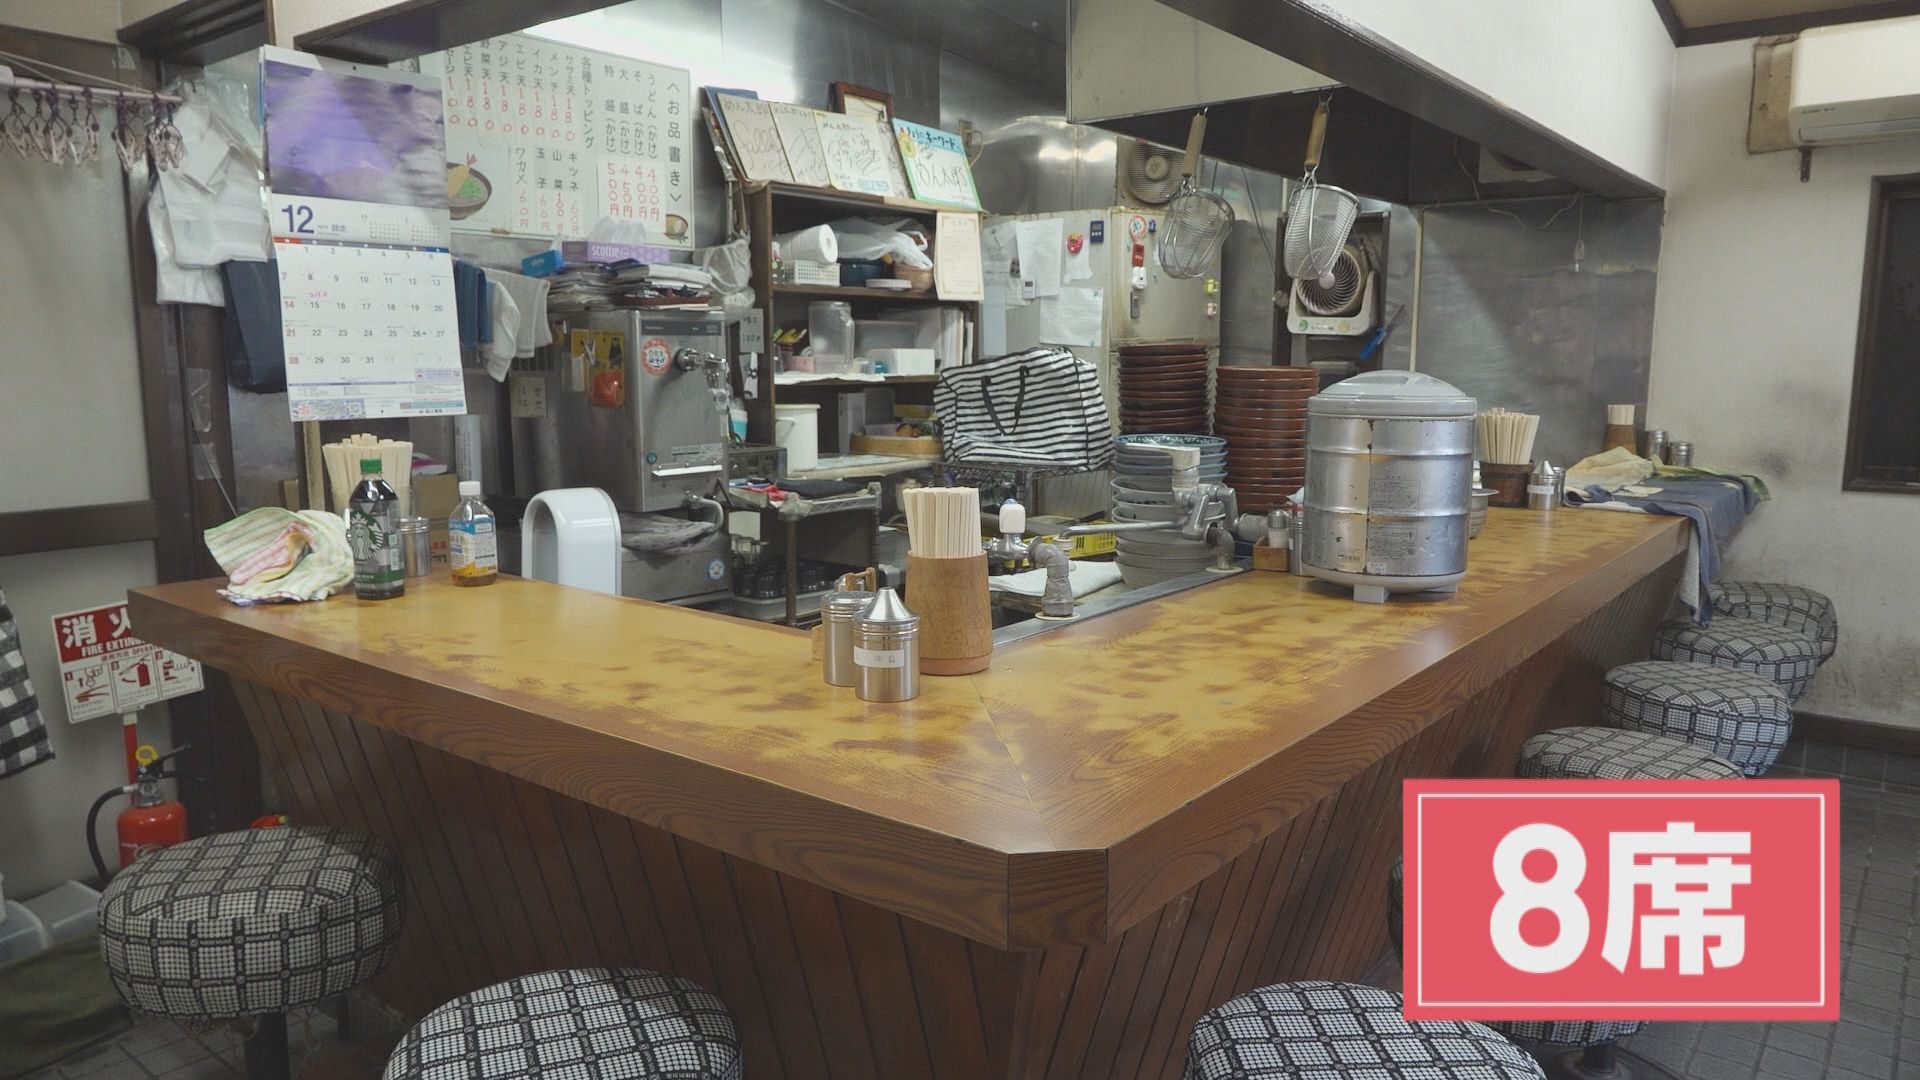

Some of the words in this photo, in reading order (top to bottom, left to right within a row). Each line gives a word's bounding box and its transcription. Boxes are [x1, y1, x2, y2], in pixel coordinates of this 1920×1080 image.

[499, 39, 510, 84] アジ天
[515, 43, 527, 88] エビ天
[533, 48, 543, 90] イカ天
[581, 56, 595, 149] 各種トッピング
[515, 147, 528, 185] ワカメ
[536, 147, 547, 189] 玉子
[568, 152, 579, 192] キツネ
[281, 204, 315, 234] 12
[281, 272, 288, 281] 7
[307, 273, 314, 281] 8
[333, 274, 340, 282] 9
[360, 275, 369, 284] 10
[384, 276, 393, 285] 11
[408, 277, 417, 286] 12
[432, 278, 441, 287] 13
[284, 300, 295, 309] 14
[310, 301, 320, 310] 15
[336, 301, 346, 310] 16
[362, 302, 371, 311] 17
[387, 303, 396, 311] 18
[411, 304, 420, 312] 19
[434, 304, 443, 312] 20
[286, 328, 296, 337] 21
[312, 328, 322, 337] 22
[338, 329, 348, 337] 23
[363, 329, 373, 337] 24
[388, 329, 398, 338] 25
[412, 329, 422, 338] 26
[436, 329, 445, 338] 27
[288, 355, 299, 365] 28
[314, 355, 324, 364] 29
[341, 356, 350, 364] 30
[365, 355, 374, 364] 31
[81, 642, 104, 657] FIRE
